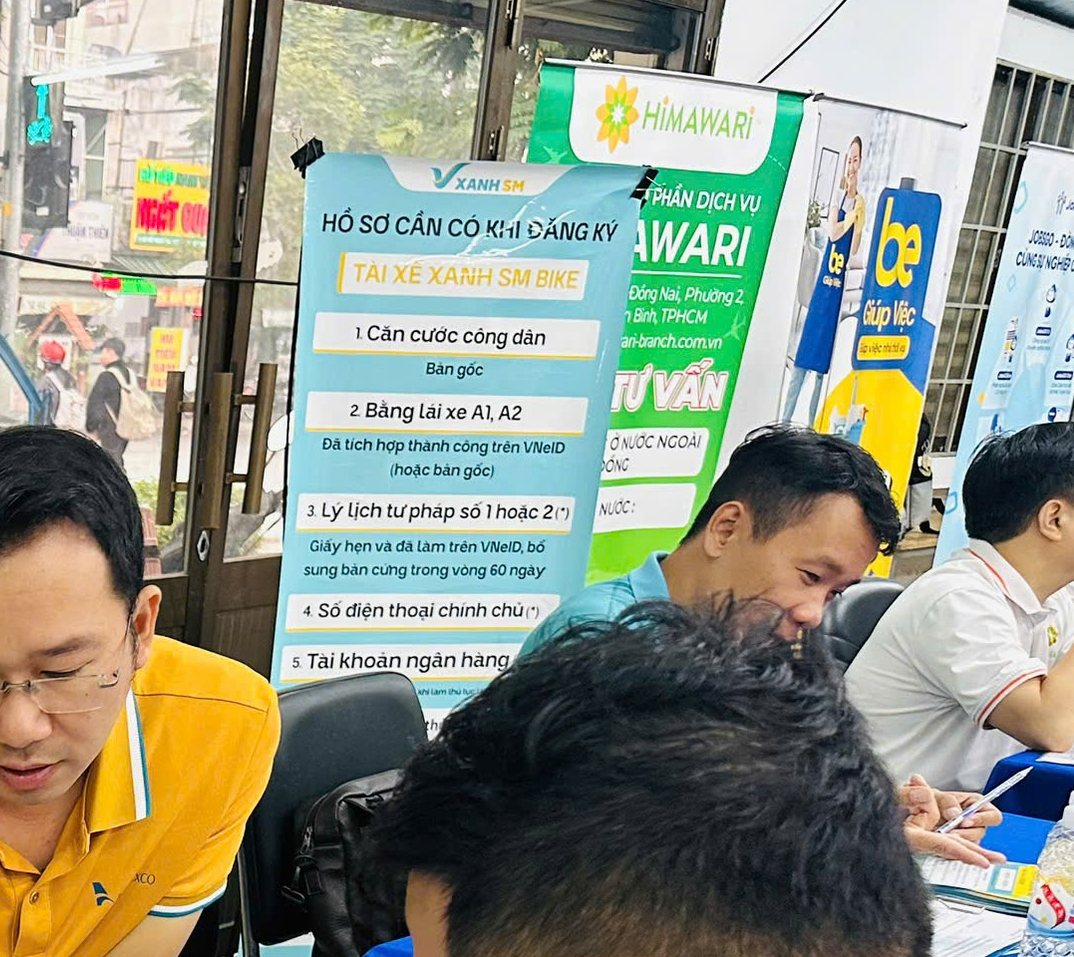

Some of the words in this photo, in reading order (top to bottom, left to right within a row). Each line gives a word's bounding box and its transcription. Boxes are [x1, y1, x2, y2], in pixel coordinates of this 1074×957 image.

[455, 178, 500, 191] XANH
[502, 180, 524, 192] SM
[652, 184, 693, 209] PHẦN
[697, 191, 736, 214] DỊCH
[740, 194, 761, 216] VỤ
[322, 207, 354, 232] HỒ
[359, 214, 390, 234] SƠ
[395, 211, 442, 237] CẦN
[448, 215, 479, 237] CÓ
[486, 220, 520, 239] KHI
[528, 218, 588, 241] ĐĂNG
[593, 220, 618, 242] KÝ
[875, 197, 922, 288] be
[829, 244, 844, 275] be
[353, 262, 386, 284] TÀI
[428, 267, 492, 286] XANH
[499, 268, 531, 287] SM
[535, 269, 579, 289] BIKE
[684, 287, 734, 307] Phường
[661, 308, 708, 324] TPHCM
[863, 299, 891, 332] Giúp
[367, 324, 405, 342] Căn
[410, 326, 458, 343] cước
[463, 328, 508, 349] công
[512, 329, 546, 346] dân
[426, 362, 454, 376] Bản
[457, 361, 484, 379] gốc
[611, 363, 653, 412] TƯ
[653, 357, 729, 411] VẤN
[366, 400, 414, 423] Bằng
[420, 402, 441, 420] lái
[446, 408, 467, 420] xe
[471, 404, 494, 424] A1,
[498, 405, 522, 421] A2
[322, 438, 341, 450] Đã
[345, 439, 372, 452] tích
[376, 439, 404, 455] hợp
[408, 439, 450, 452] thành
[454, 441, 488, 456] công
[492, 441, 519, 454] trên
[524, 441, 565, 454] VNeID
[657, 431, 702, 449] NGOÀI
[390, 463, 430, 479] (hoặc
[433, 464, 460, 477] bản
[463, 462, 495, 480] gốc)
[321, 502, 344, 522] Lý
[348, 502, 382, 522] lịch
[387, 505, 407, 519] tư
[409, 502, 455, 523] pháp
[460, 500, 482, 520] số
[486, 504, 492, 519] 1
[496, 504, 538, 524] hoặc
[542, 504, 554, 520] 2
[309, 539, 342, 557] Giấy
[345, 540, 372, 555] hẹn
[375, 540, 392, 552] và
[396, 540, 414, 553] đã
[417, 540, 446, 553] làm
[449, 540, 477, 553] trên
[480, 541, 524, 555] VNeID,
[527, 539, 546, 554] bổ
[303, 566, 338, 579] sung
[341, 563, 369, 576] bản
[372, 563, 408, 579] cứng
[410, 564, 449, 580] trong
[452, 563, 487, 580] vòng
[489, 564, 507, 577] 60
[509, 564, 546, 580] ngày
[318, 601, 340, 618] Số
[345, 602, 384, 622] điện
[389, 602, 434, 622] thoại
[438, 602, 487, 618] chính
[491, 601, 523, 618] chủ
[307, 653, 334, 669] Tài
[339, 652, 401, 669] khoản
[407, 653, 456, 673] ngân
[461, 652, 510, 670] hàng
